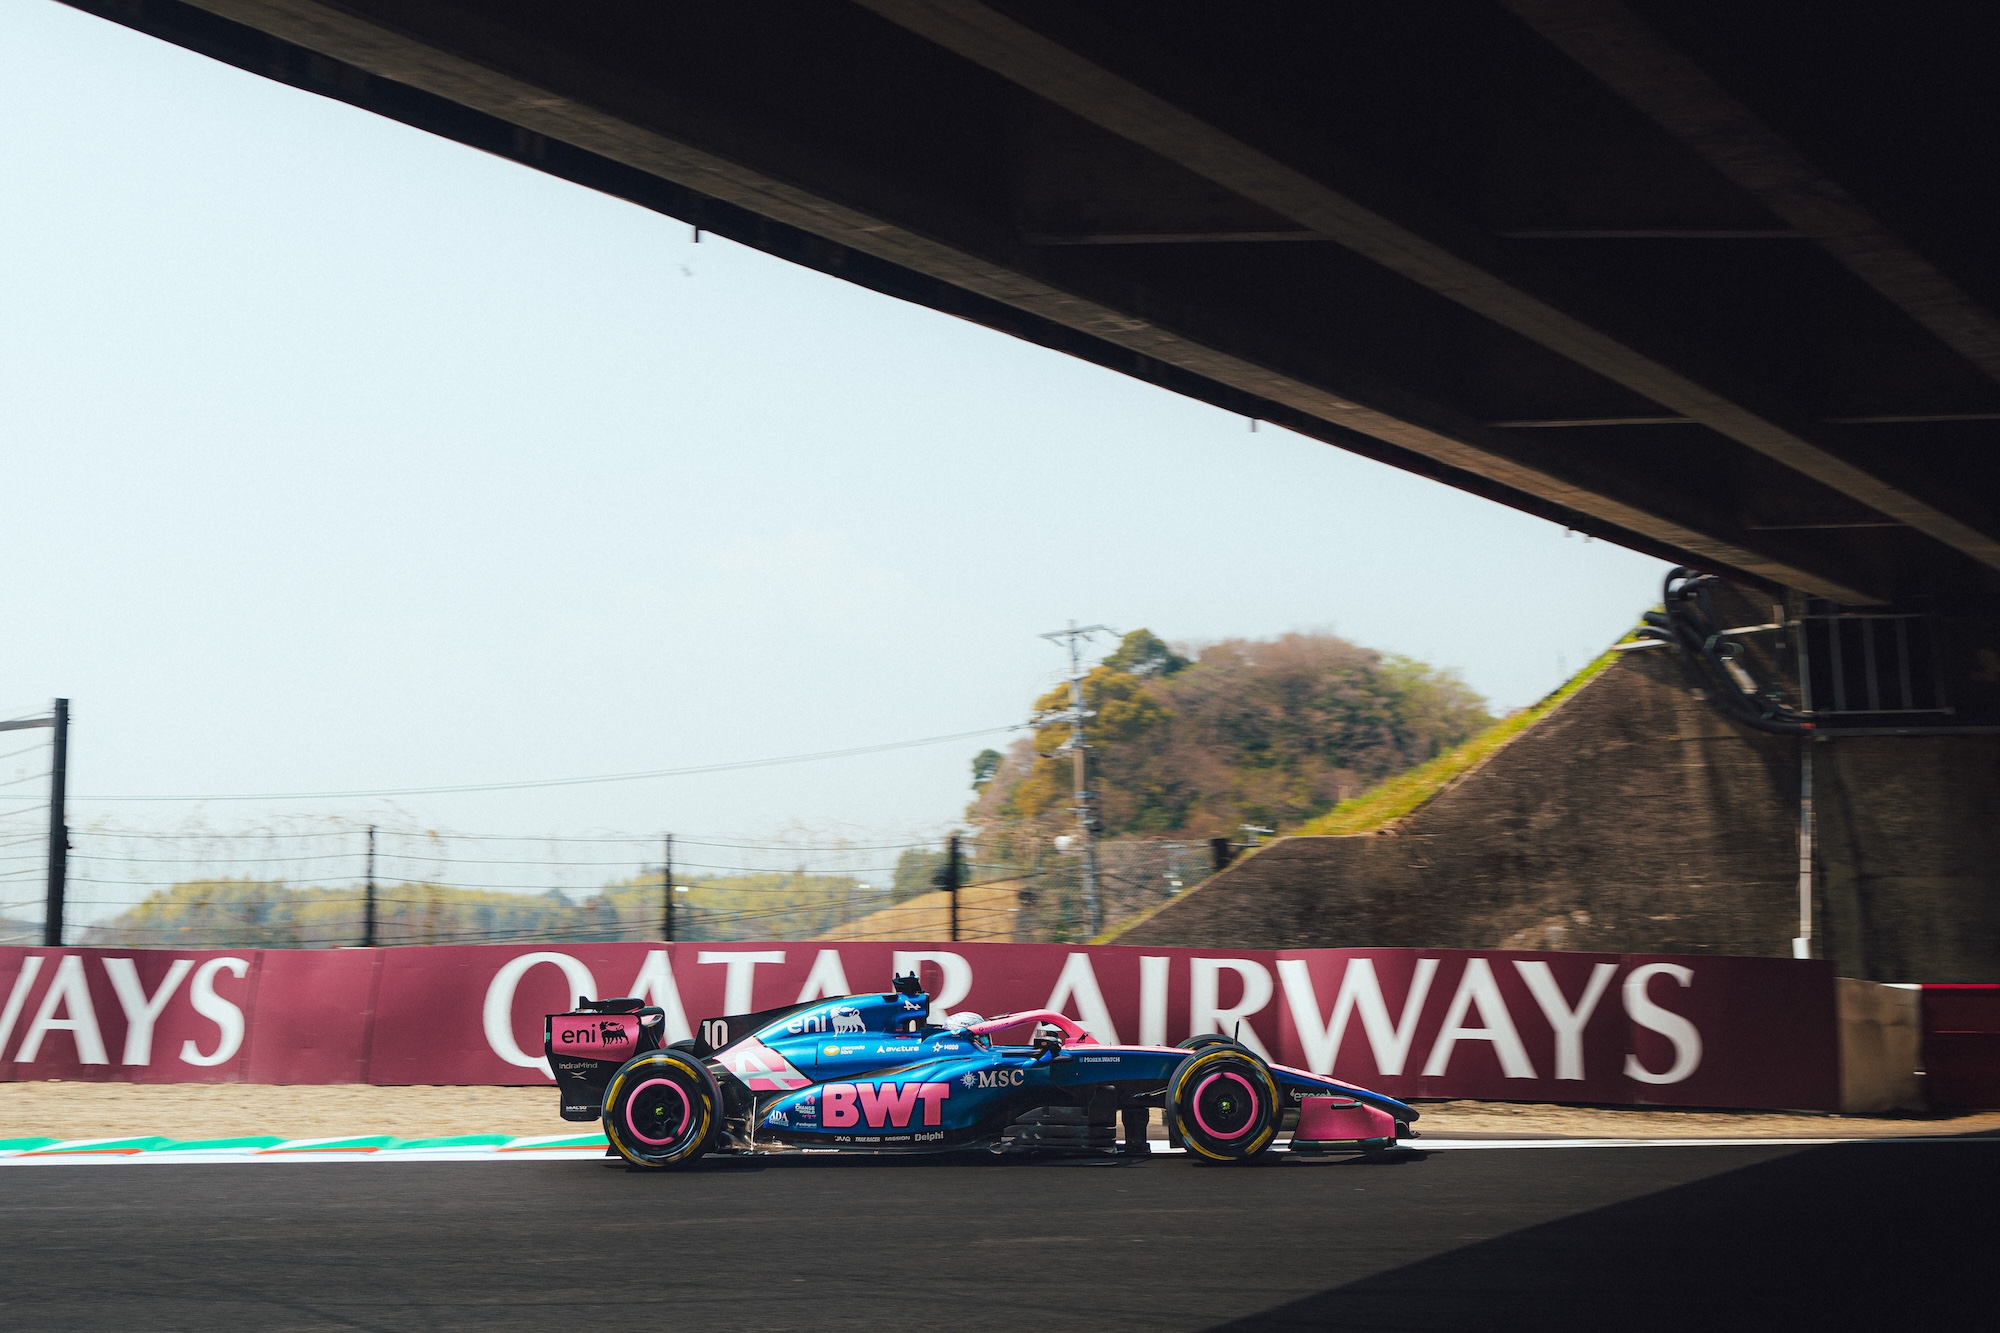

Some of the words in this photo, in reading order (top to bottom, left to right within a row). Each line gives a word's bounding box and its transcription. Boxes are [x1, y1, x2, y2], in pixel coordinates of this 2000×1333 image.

[787, 1010, 827, 1034] eni
[1028, 953, 1702, 1084] AIRWAYS
[561, 1023, 596, 1043] eni
[702, 1020, 729, 1050] 10
[558, 1061, 598, 1070] IndraMind
[978, 1069, 1025, 1089] MSC
[769, 1109, 788, 1121] ADA
[822, 1082, 950, 1128] BWT
[914, 1131, 944, 1142] Delphi
